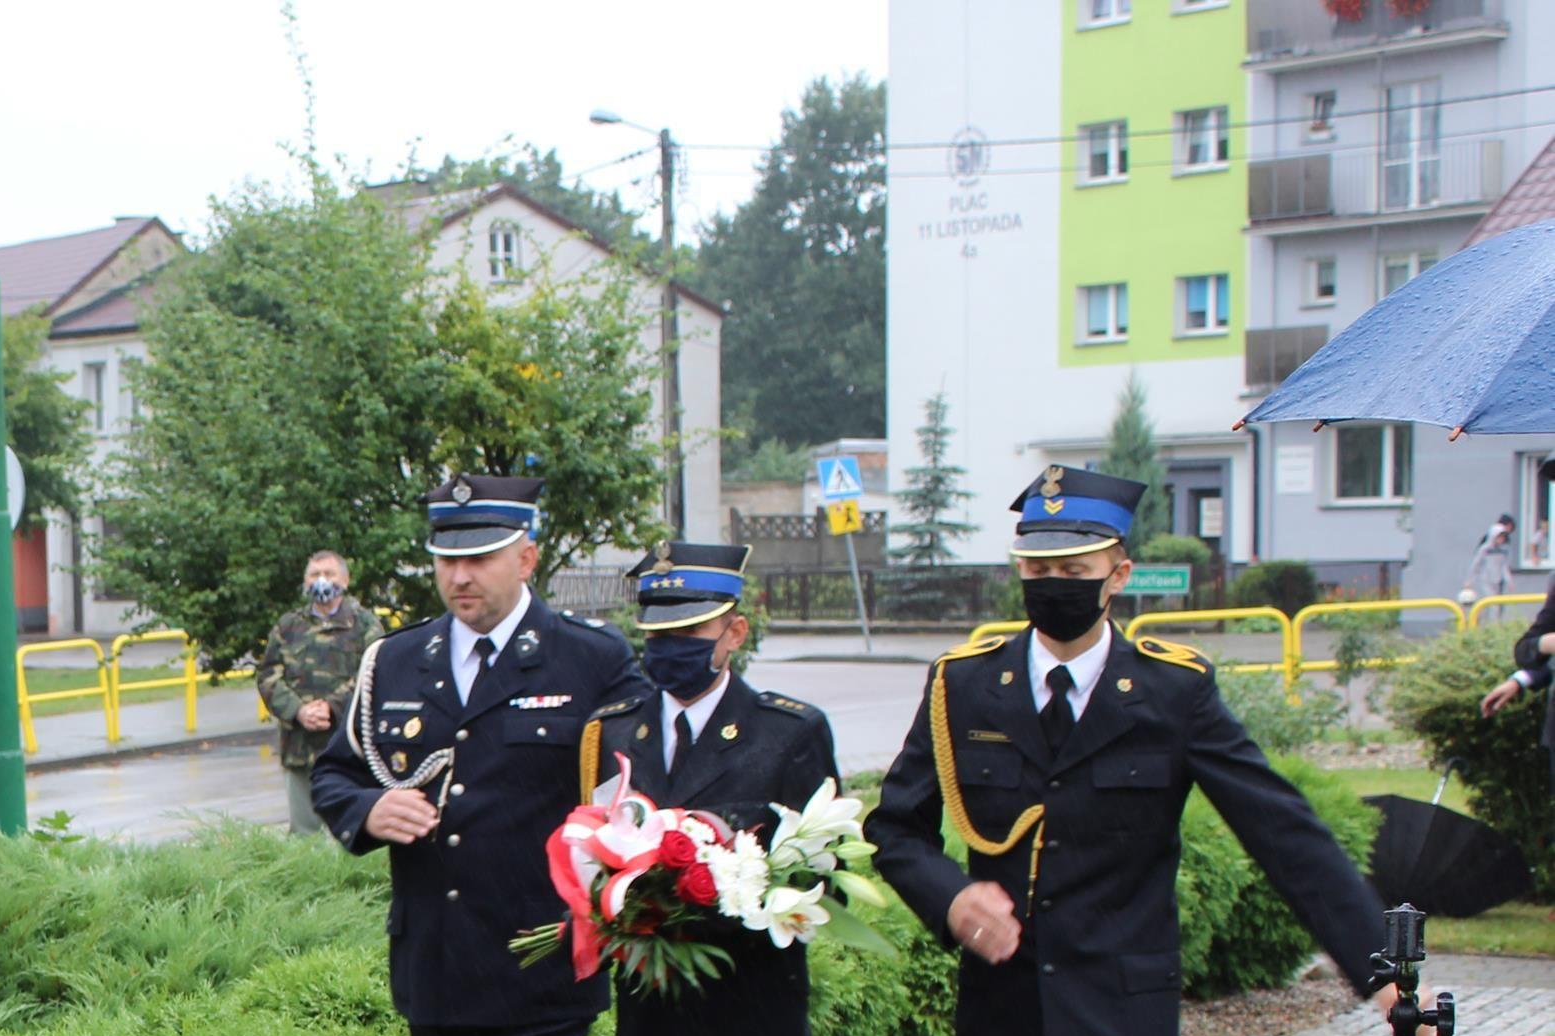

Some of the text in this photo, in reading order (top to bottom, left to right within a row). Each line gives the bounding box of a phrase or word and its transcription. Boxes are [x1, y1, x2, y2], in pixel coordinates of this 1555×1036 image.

[949, 192, 988, 212] PLAC
[918, 213, 1022, 240] 11 LISTOPADA
